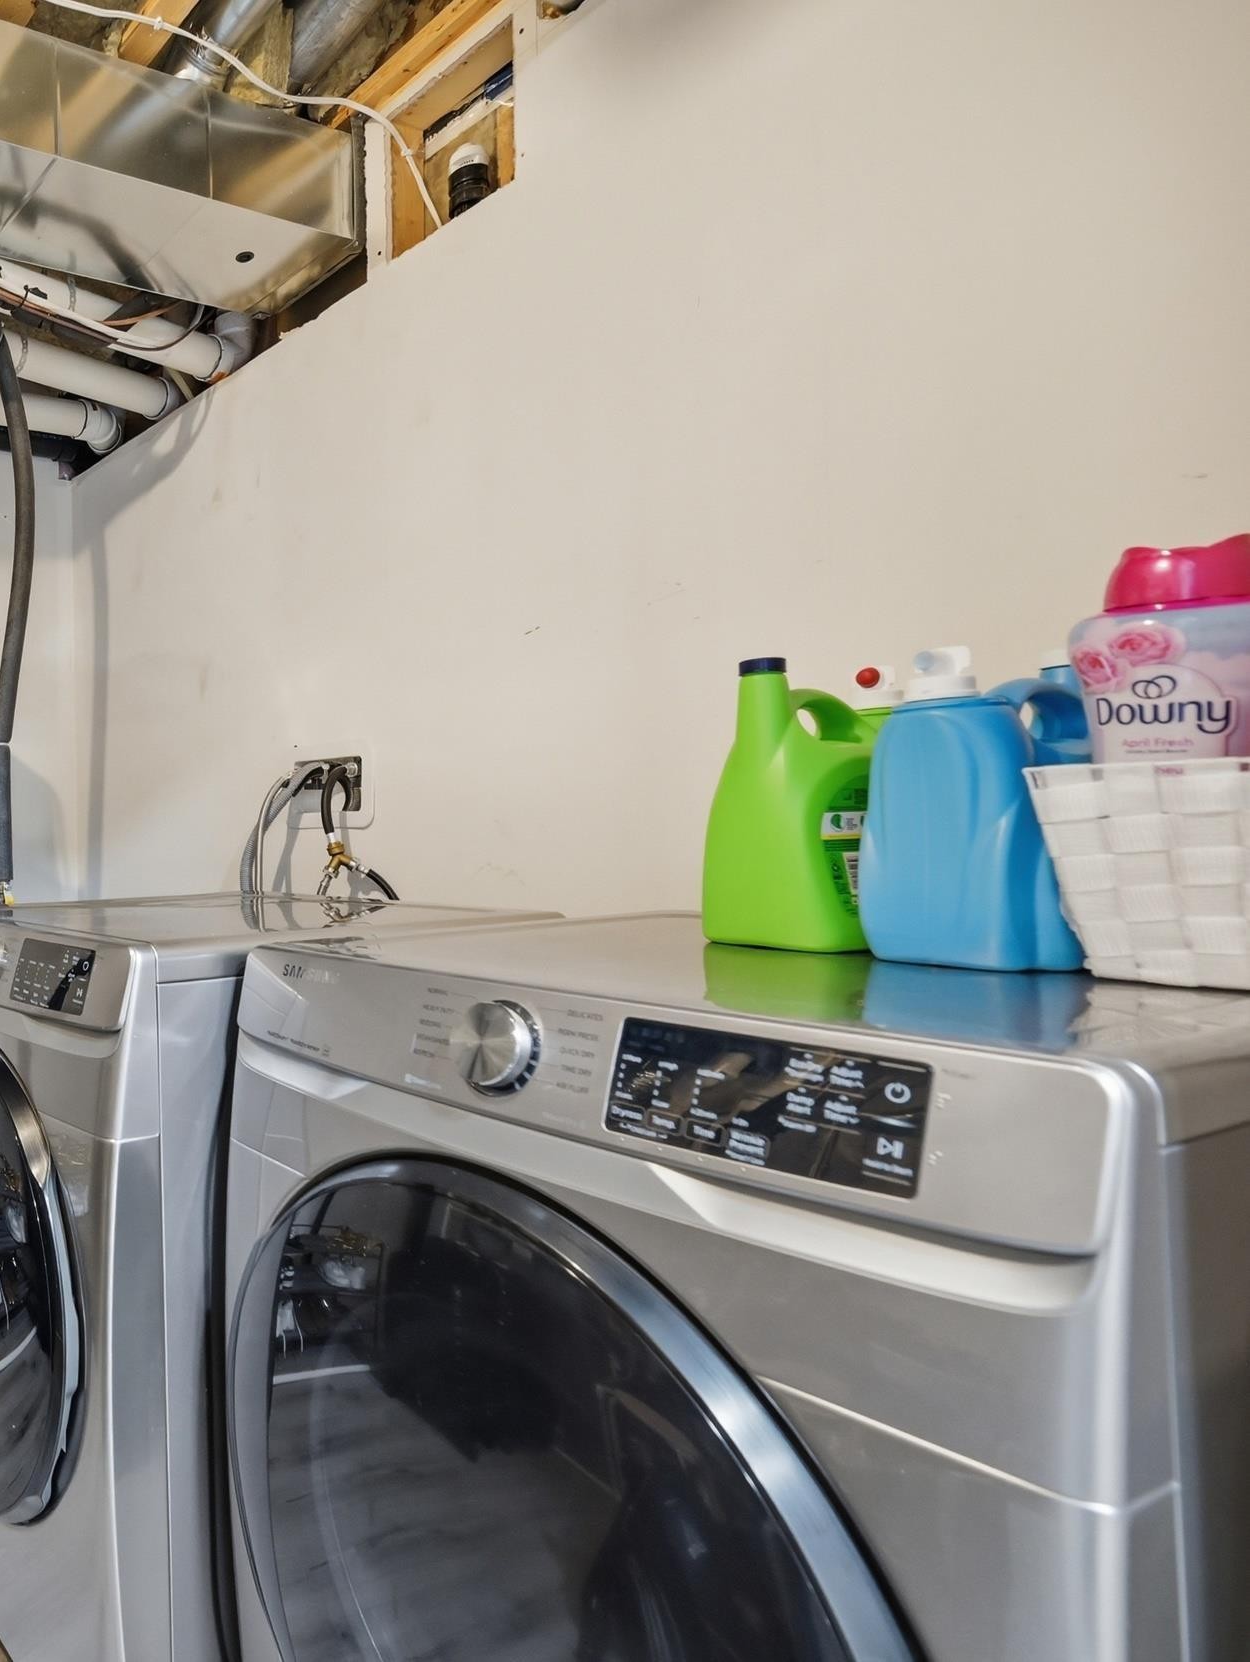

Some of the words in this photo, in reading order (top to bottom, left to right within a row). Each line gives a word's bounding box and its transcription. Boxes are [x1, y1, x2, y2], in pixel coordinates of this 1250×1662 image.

[1096, 698, 1231, 734] Downy
[1122, 738, 1151, 748] April
[1155, 737, 1195, 747] Fresh
